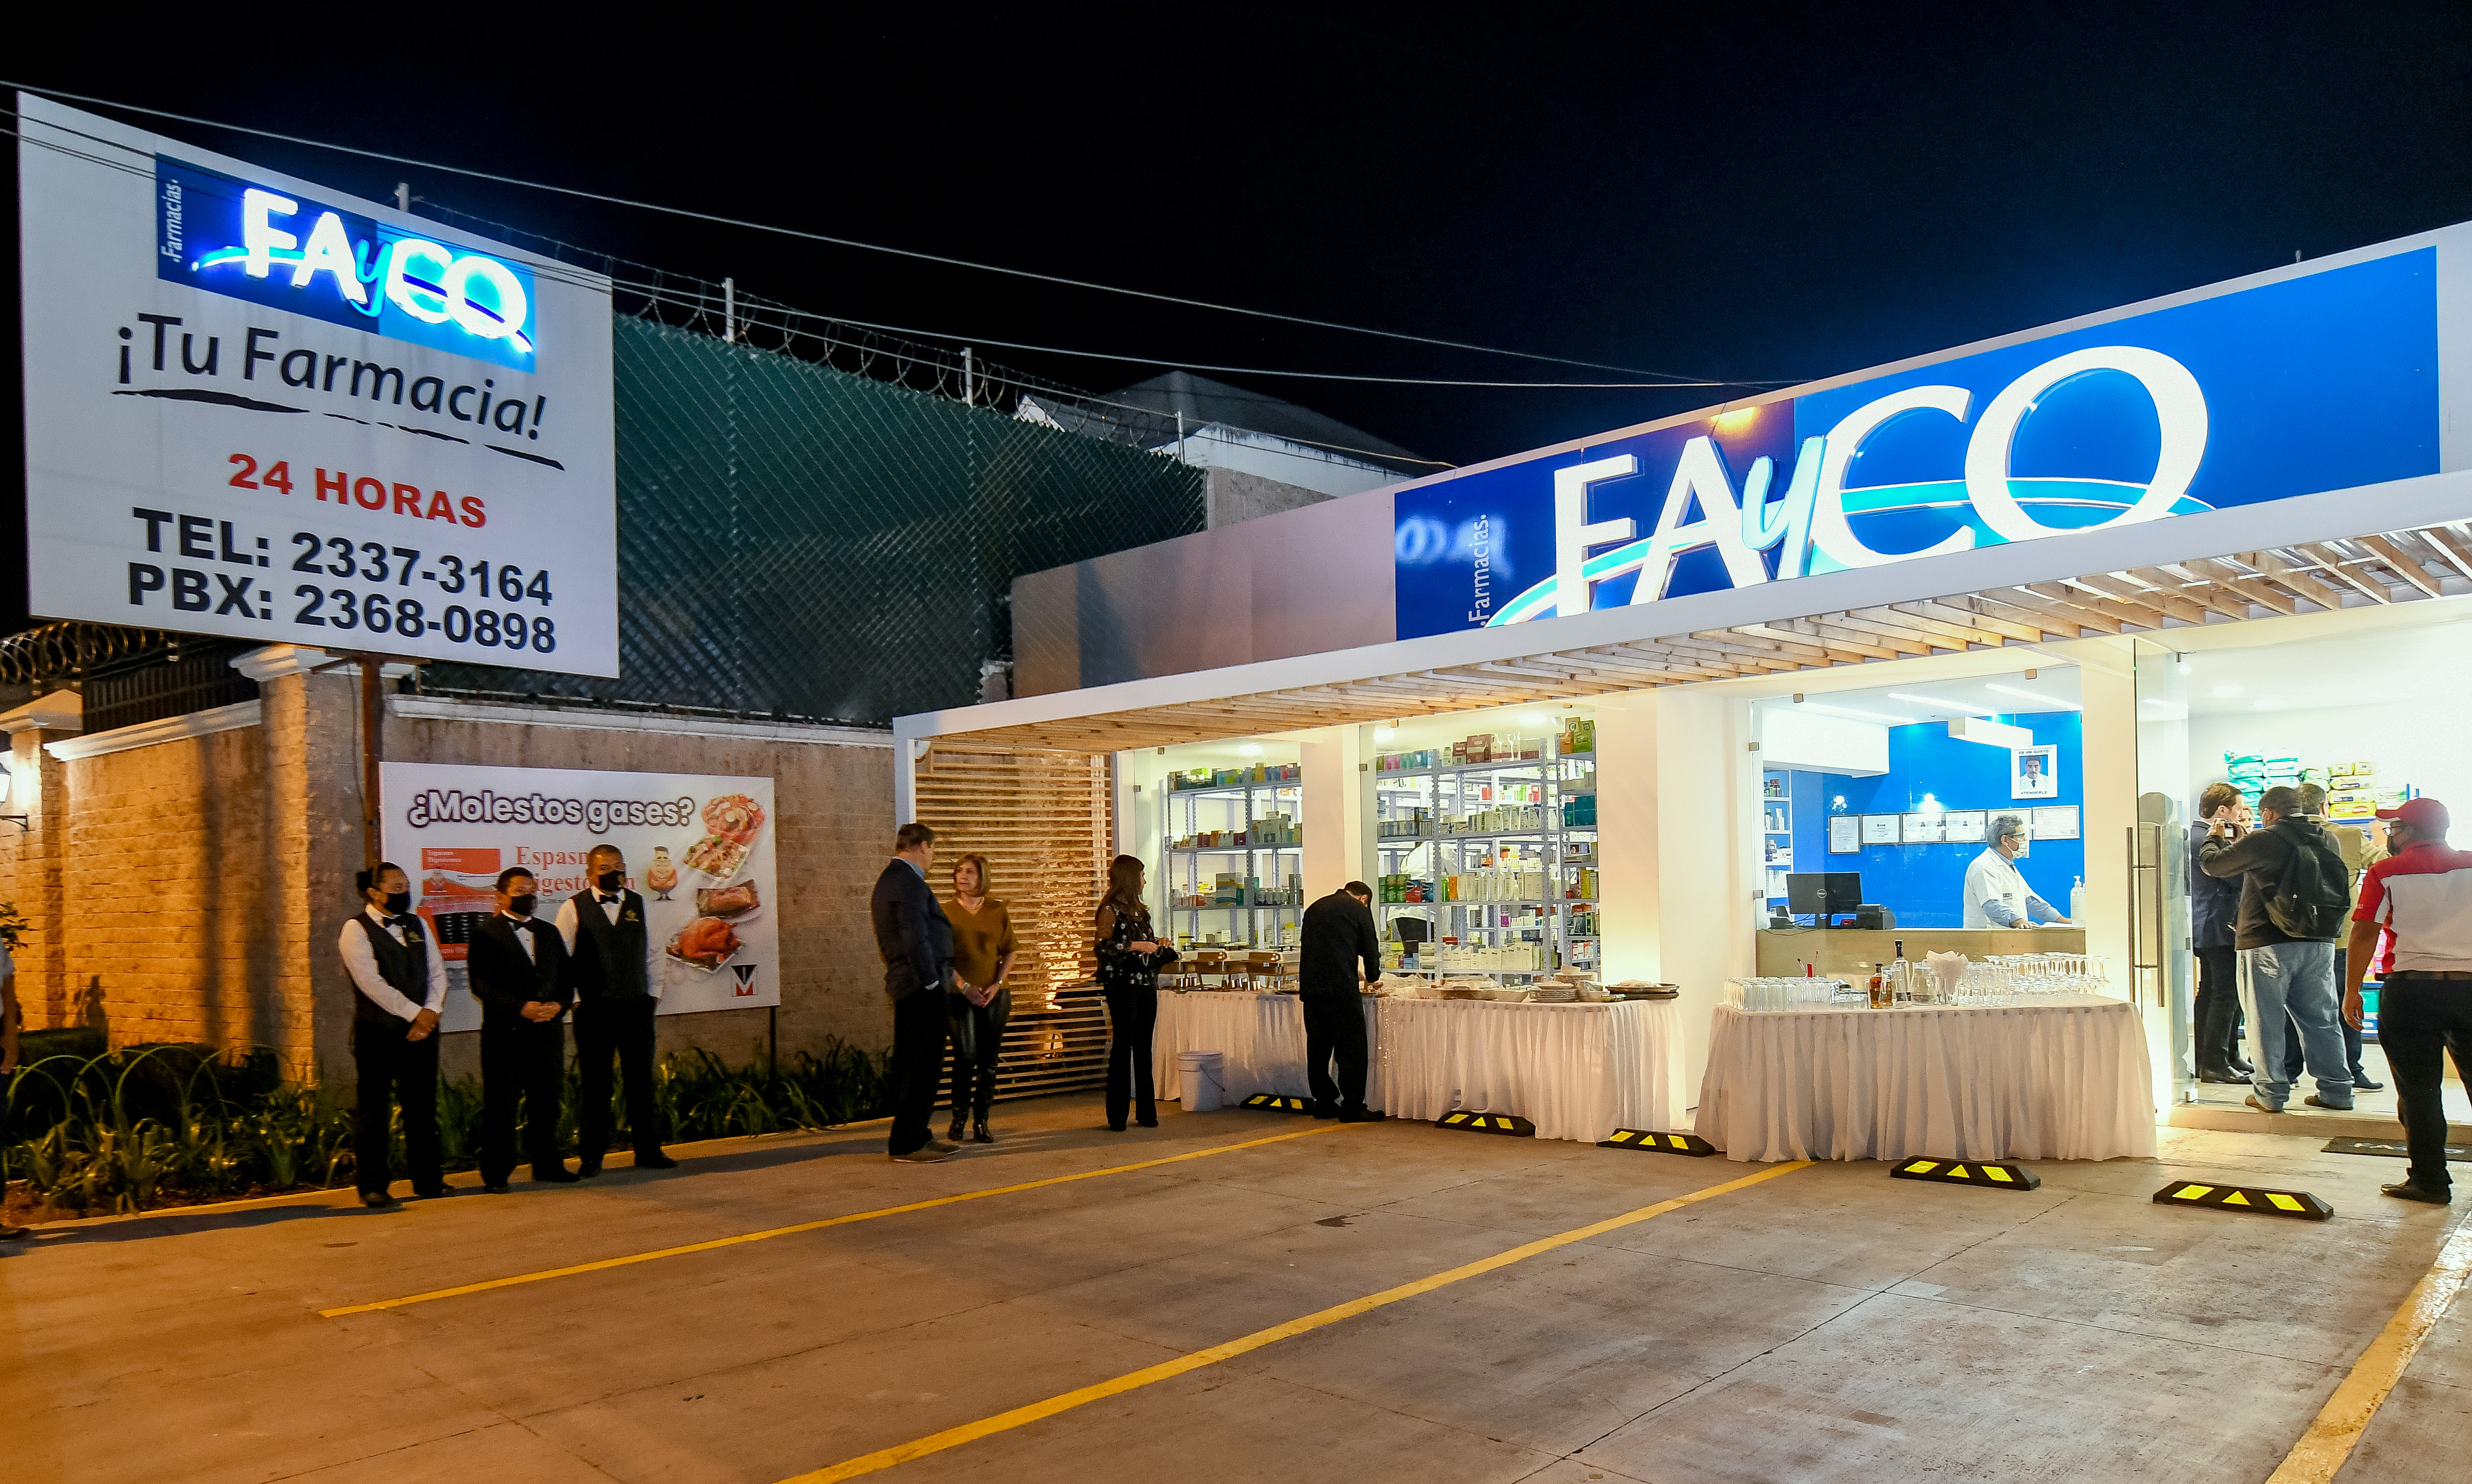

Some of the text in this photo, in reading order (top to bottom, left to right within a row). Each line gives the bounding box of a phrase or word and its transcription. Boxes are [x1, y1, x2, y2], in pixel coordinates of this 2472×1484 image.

[118, 312, 547, 441] ¡Tu Farmacia!
[229, 453, 487, 528] 24 HORAS
[132, 506, 553, 607] TEL: 2337-3164
[127, 561, 556, 653] PBX: 2368-0898
[408, 789, 696, 834] ¿Molestos gases?
